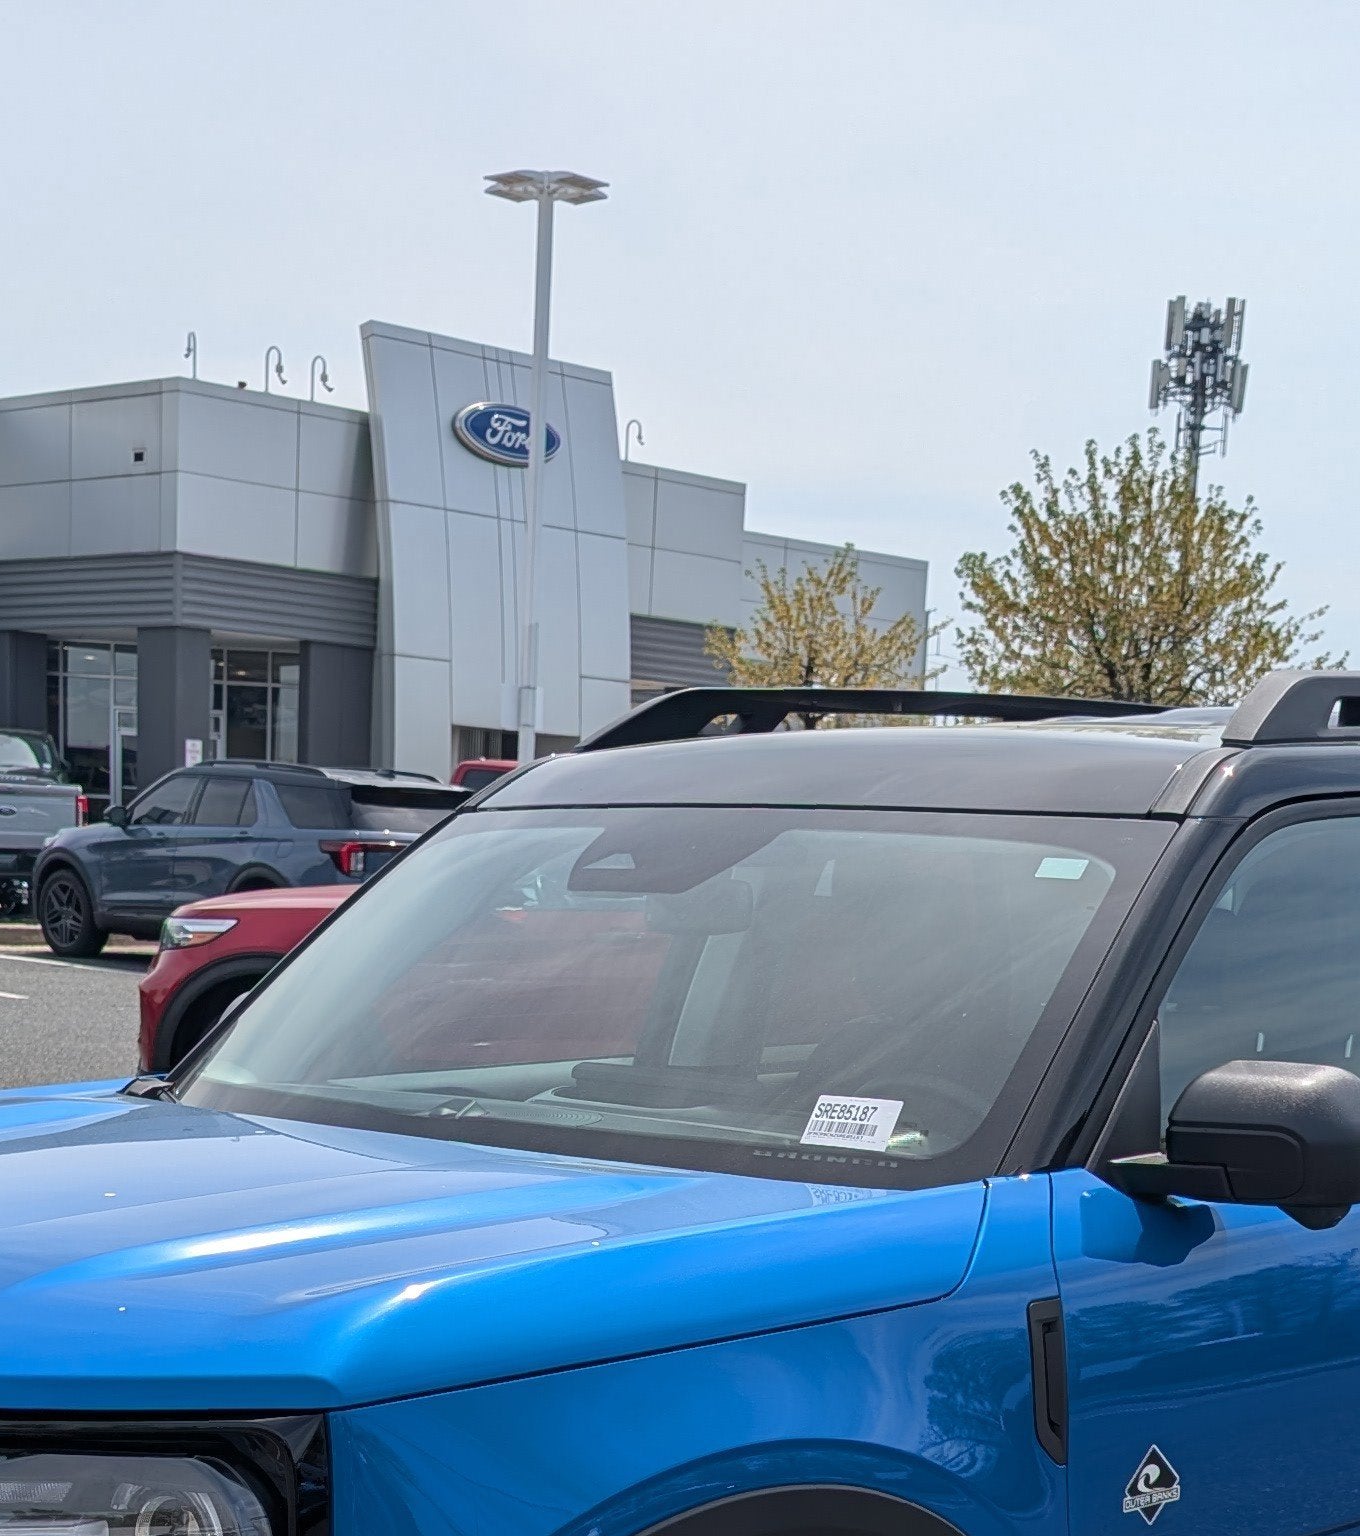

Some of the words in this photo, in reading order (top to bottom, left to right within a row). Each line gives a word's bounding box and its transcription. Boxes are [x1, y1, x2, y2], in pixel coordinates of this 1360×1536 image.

[485, 413, 531, 450] For
[815, 1102, 878, 1123] SRE85187
[1125, 1495, 1151, 1510] OUTER
[1152, 1489, 1178, 1502] BANKS
